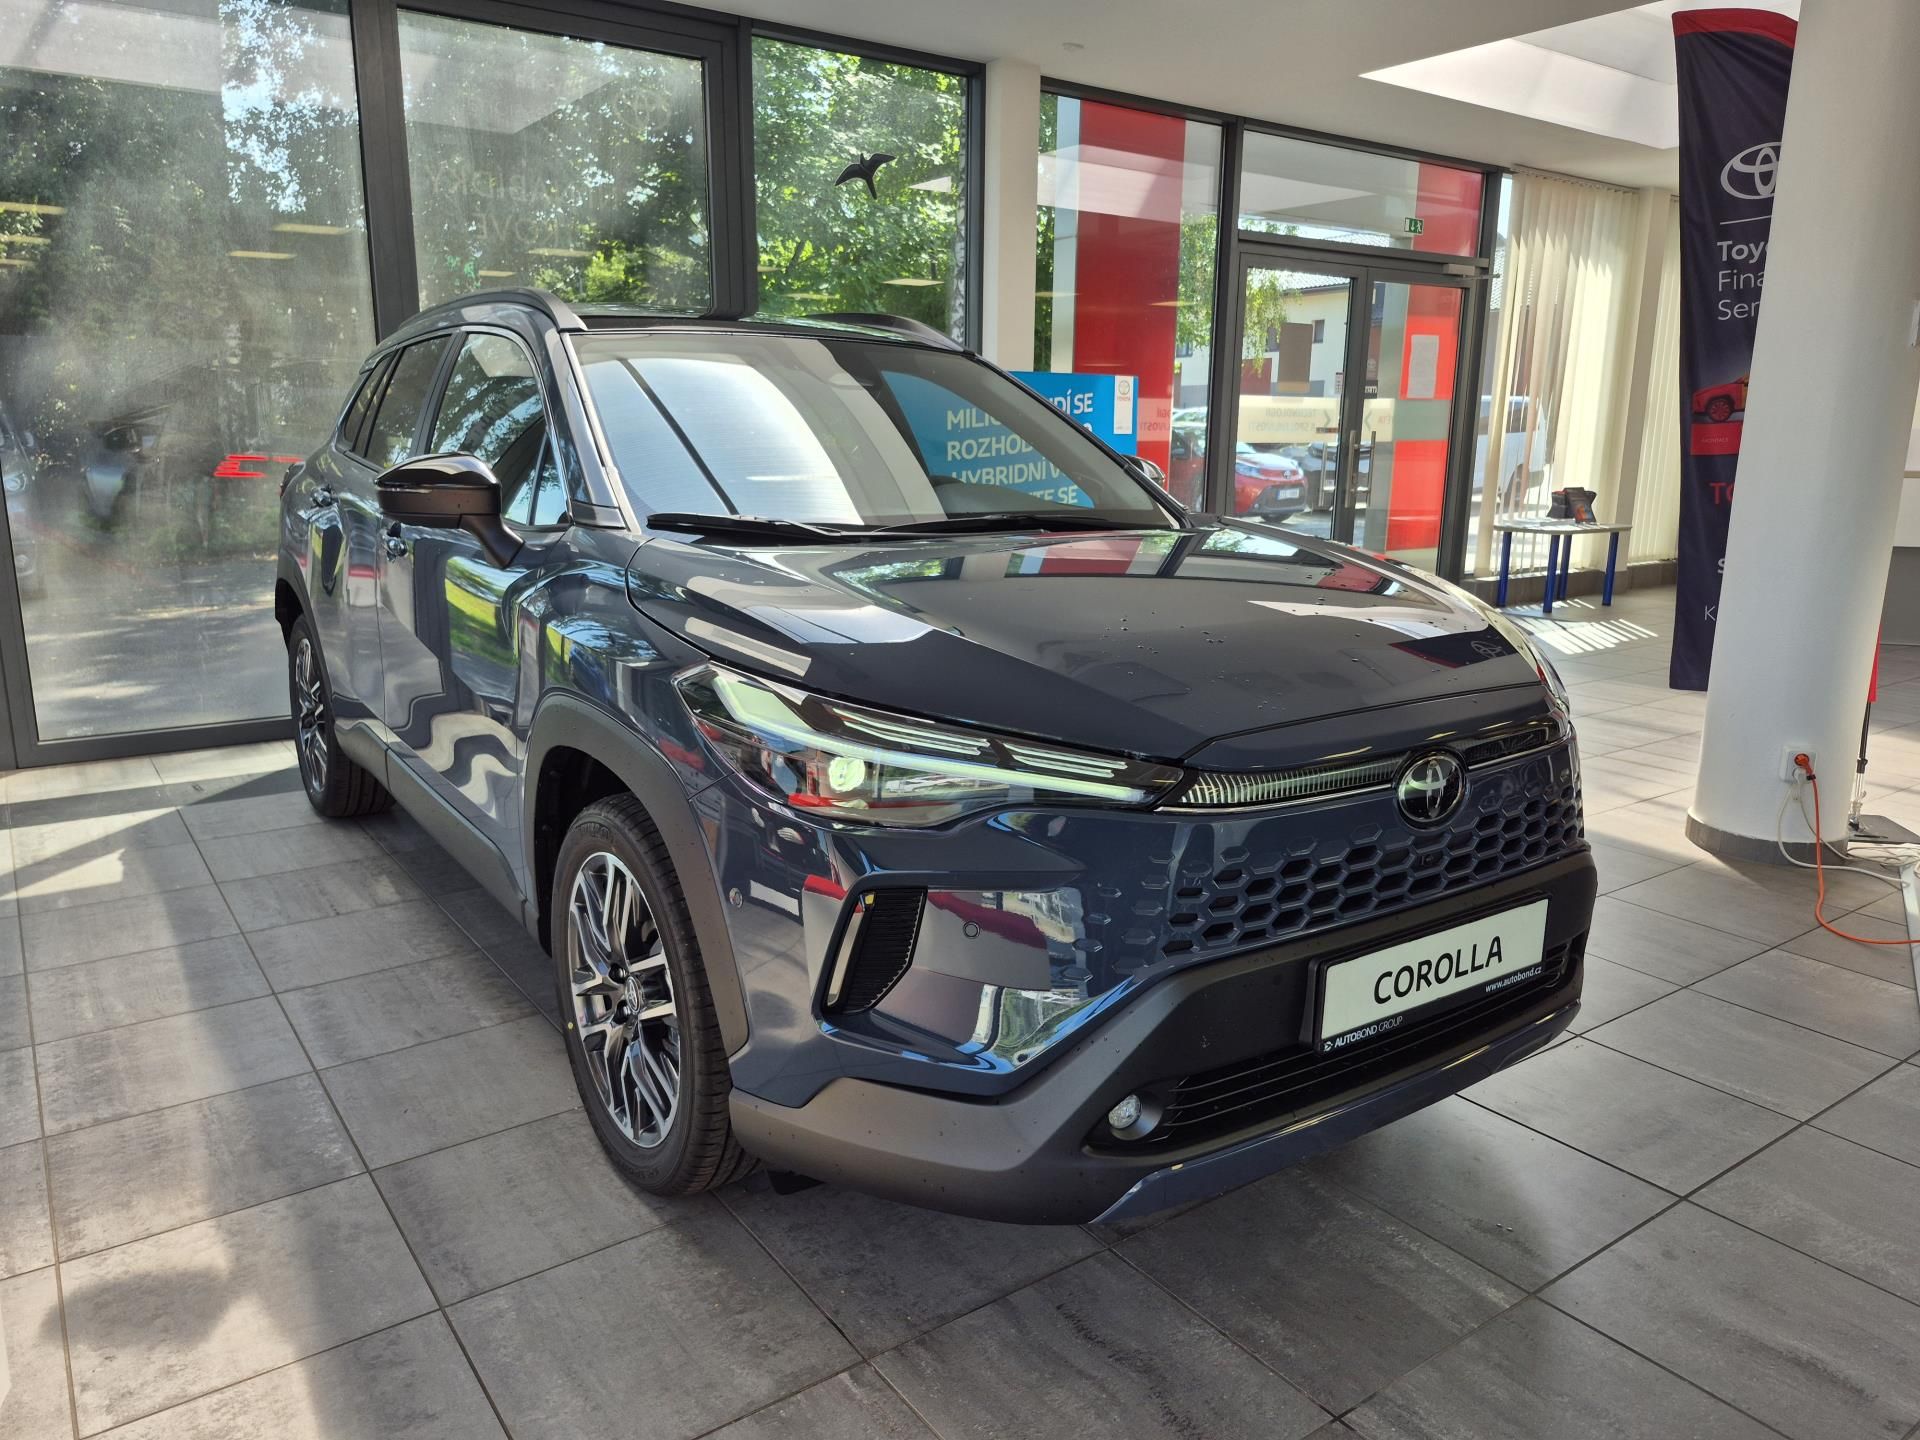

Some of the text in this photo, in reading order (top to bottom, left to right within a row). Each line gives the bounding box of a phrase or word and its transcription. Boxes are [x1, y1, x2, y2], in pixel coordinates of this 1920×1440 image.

[1717, 241, 1766, 264] Toy
[1718, 269, 1764, 292] Fina
[1717, 299, 1760, 320] Ser
[1073, 393, 1093, 414] SE
[952, 457, 1063, 486] HYBRIDNÍ V
[1056, 485, 1078, 504] SE
[1374, 936, 1503, 1004] COROLLA
[1485, 966, 1542, 992] www.autobond.cz
[1334, 1015, 1403, 1048] AUTOBOND GROUP
